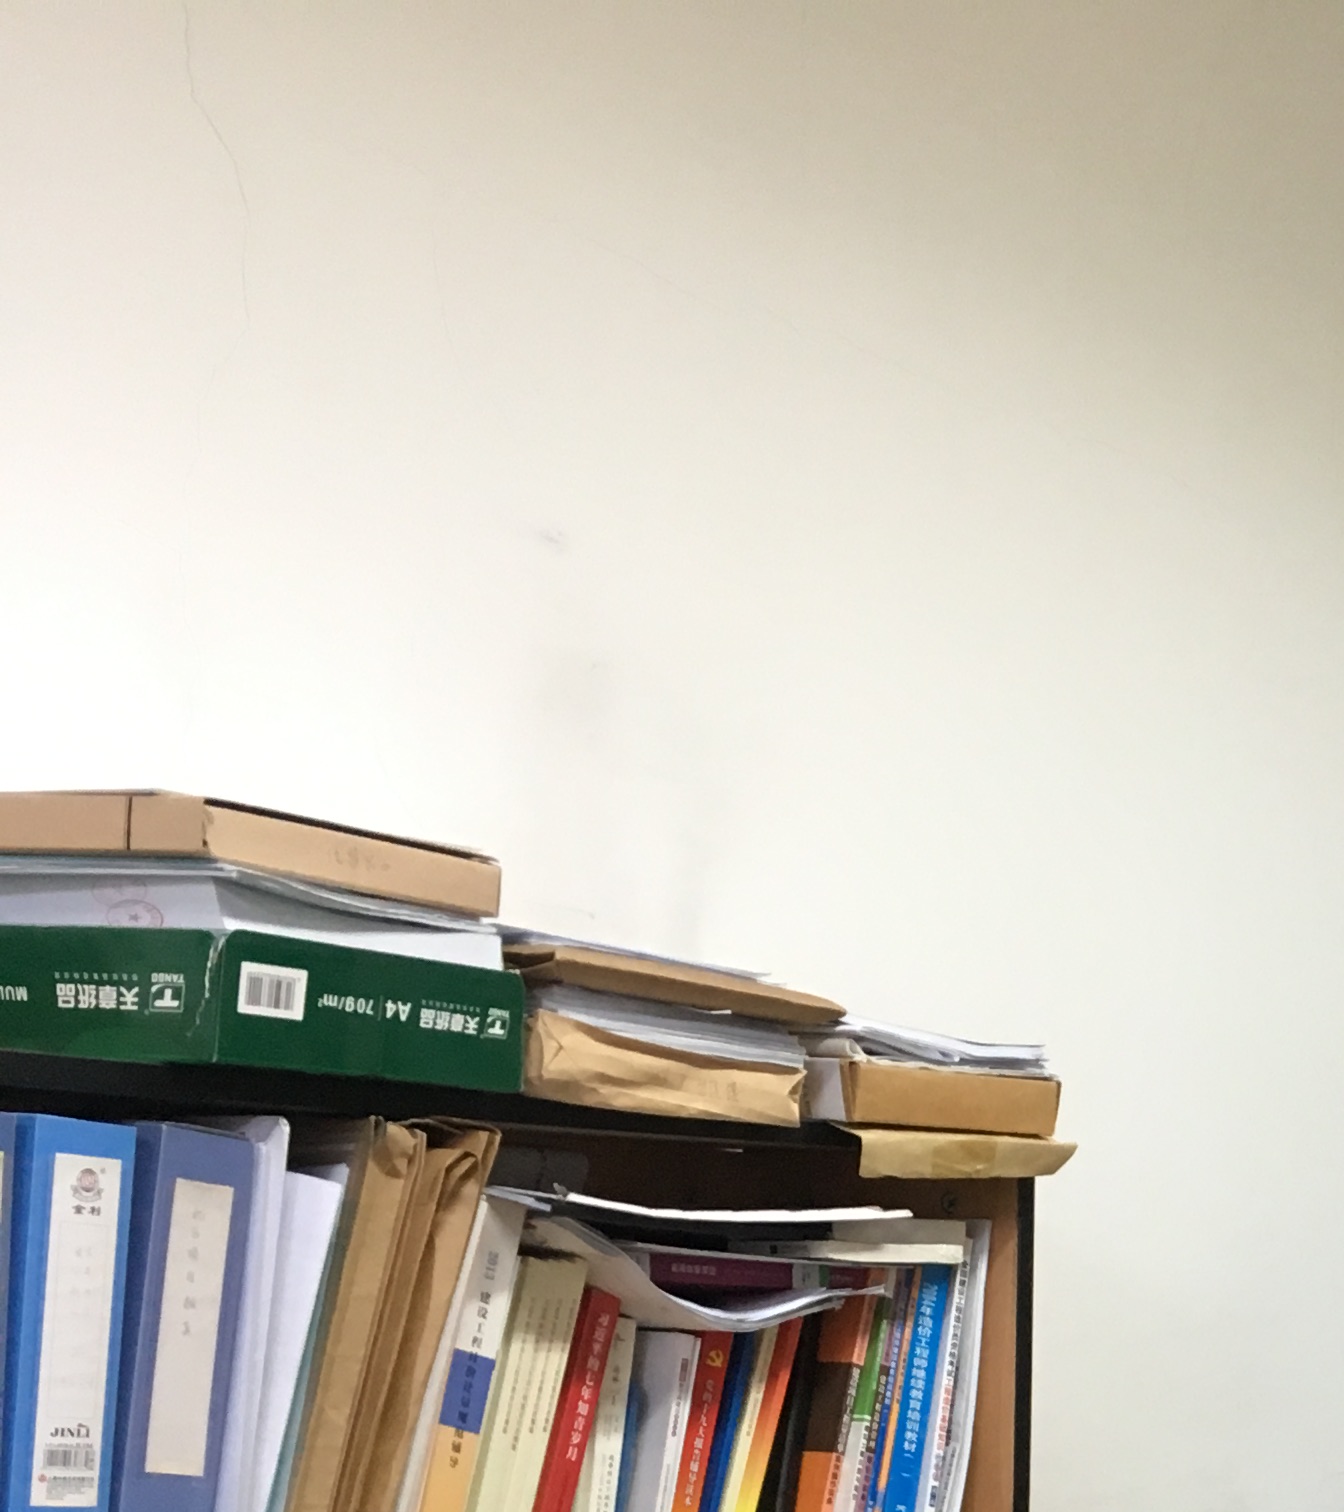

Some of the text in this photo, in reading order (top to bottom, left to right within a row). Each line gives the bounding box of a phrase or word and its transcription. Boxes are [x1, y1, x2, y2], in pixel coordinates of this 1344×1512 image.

[55, 982, 139, 1011] 天章纸品
[385, 999, 412, 1022] A4
[419, 1008, 480, 1035] 天章纸品
[565, 1313, 610, 1462] 习近平的七年知青岁月
